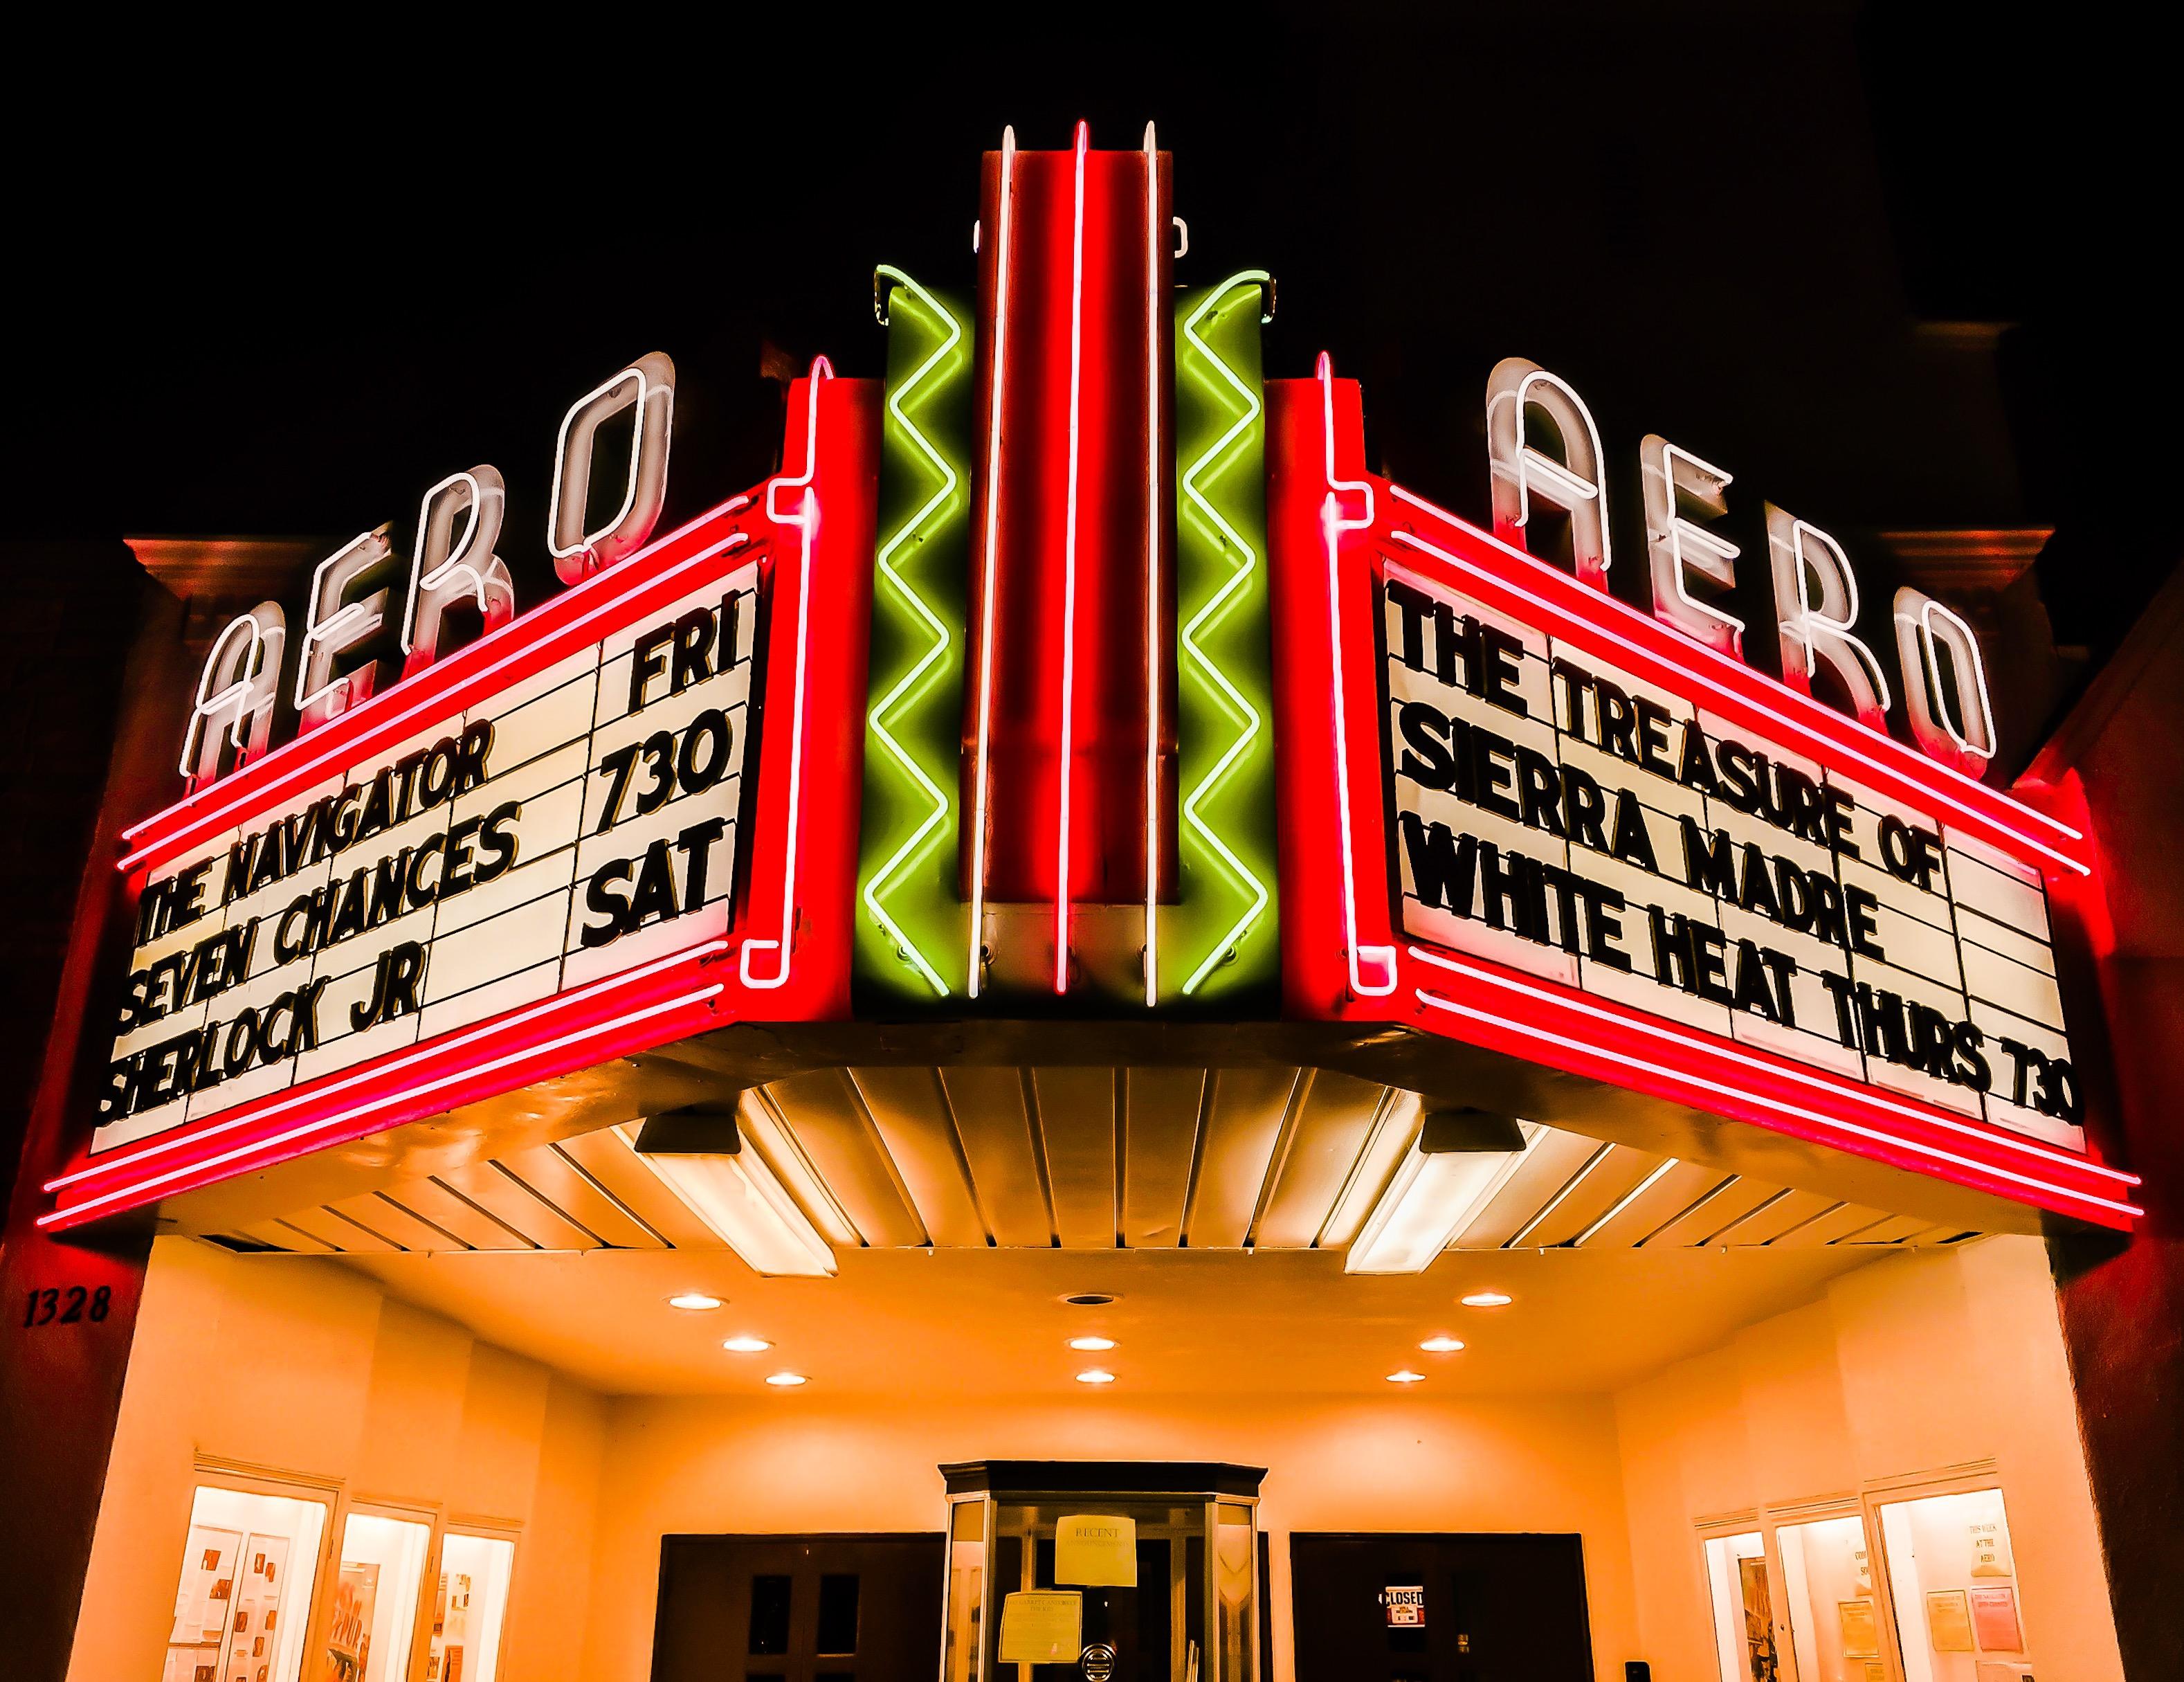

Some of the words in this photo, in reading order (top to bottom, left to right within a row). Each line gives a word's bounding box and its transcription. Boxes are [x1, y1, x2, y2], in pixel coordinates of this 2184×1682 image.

[179, 351, 675, 786] AERO
[1486, 356, 1997, 772] AERO
[116, 916, 260, 1037] SEVEN
[273, 801, 521, 966] CHANCES
[595, 708, 734, 836] 730
[139, 855, 214, 948] THE
[223, 718, 495, 908] NAVIGATOR
[628, 589, 741, 717] FRI
[1386, 579, 1527, 720] THE
[1551, 656, 1861, 862] TREASURE
[1877, 814, 1944, 894] OF
[1399, 701, 1660, 875] SIERRA
[1680, 814, 1887, 964] MADRE
[92, 975, 330, 1129] SHERLOCK
[350, 940, 428, 1033] JR
[580, 817, 726, 948] SAT
[1399, 811, 1632, 975] WHITE
[1647, 903, 1799, 1030] HEAT
[1821, 969, 1993, 1094] THURS
[1999, 1036, 2084, 1126] 730
[24, 1285, 111, 1328] 1328
[1075, 1528, 1120, 1537] RECENT
[1381, 1591, 1423, 1607] CLOSED
